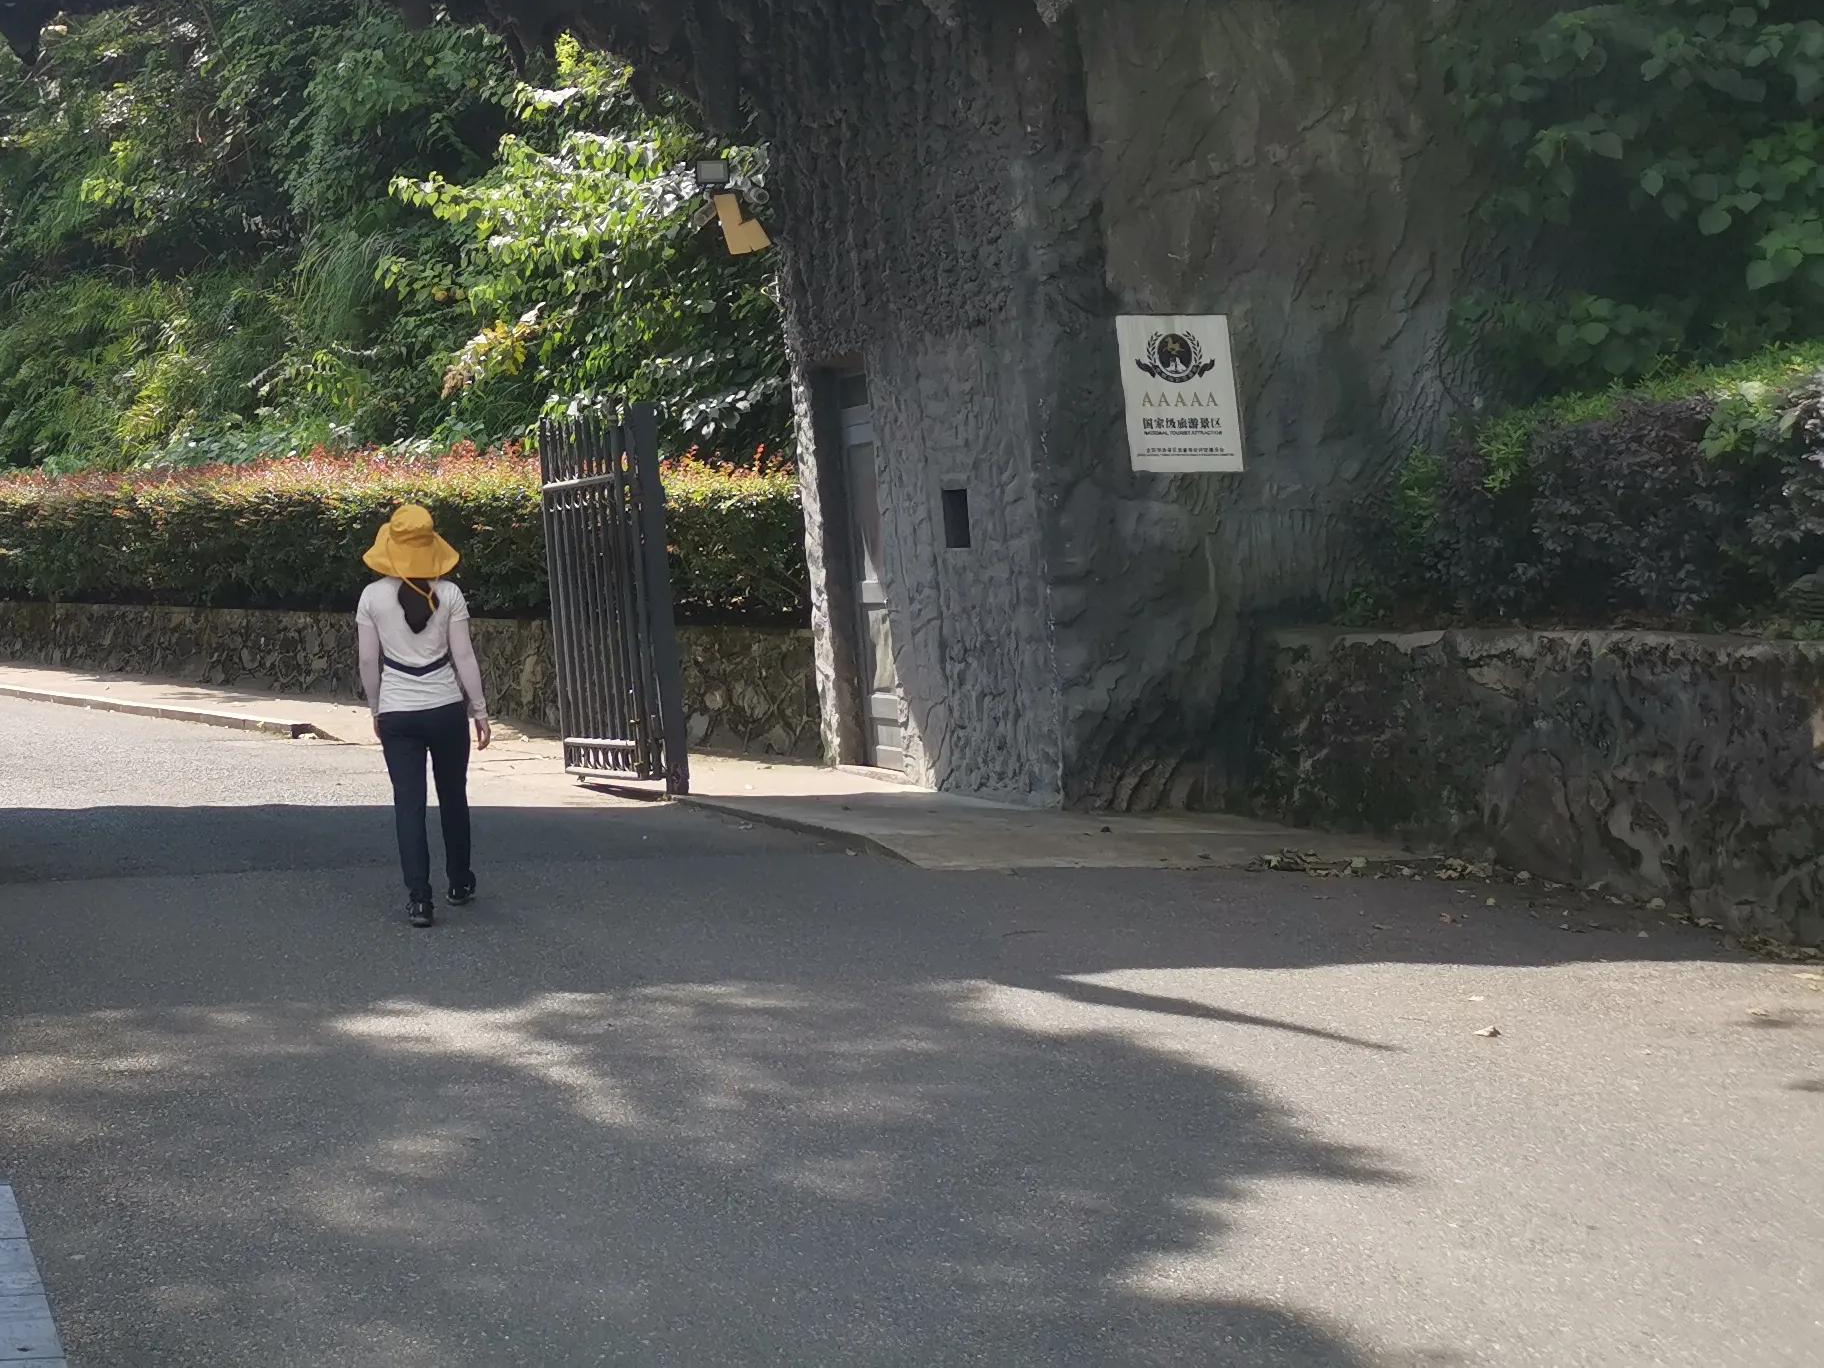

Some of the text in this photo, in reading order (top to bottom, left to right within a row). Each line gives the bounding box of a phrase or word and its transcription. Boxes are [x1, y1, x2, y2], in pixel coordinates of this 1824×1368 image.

[1143, 417, 1222, 429] 国家级旅游景区
